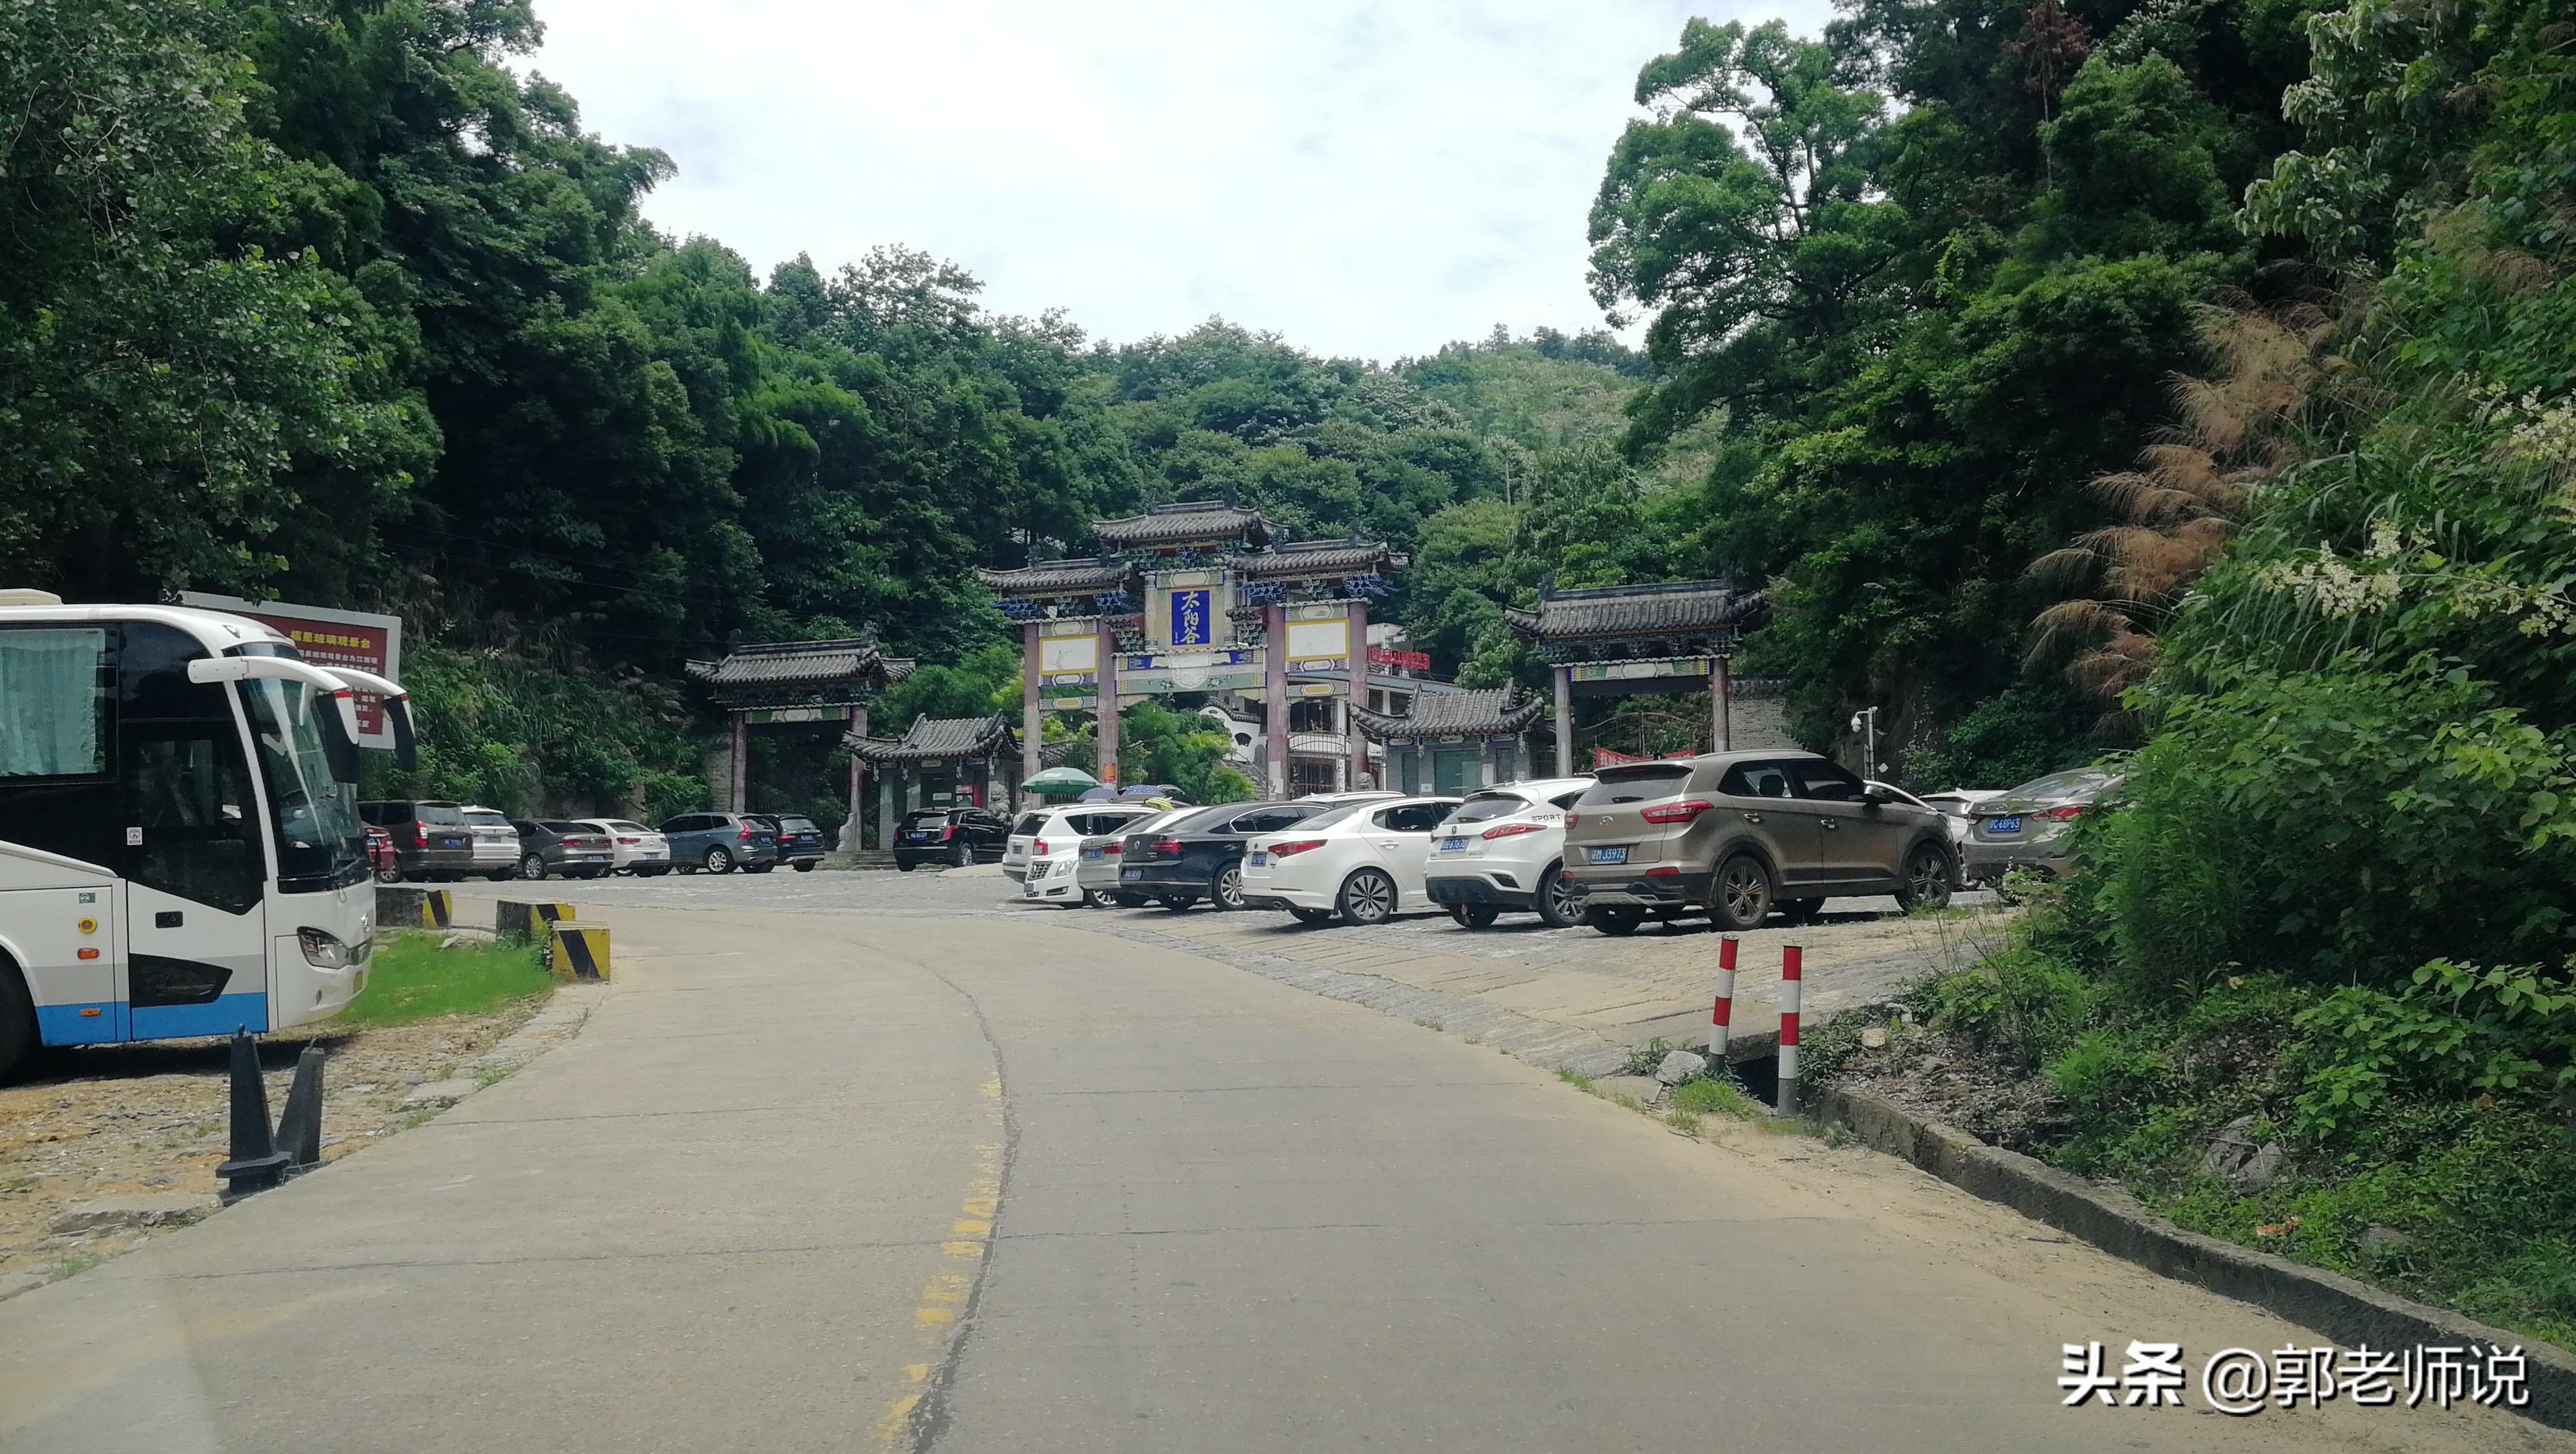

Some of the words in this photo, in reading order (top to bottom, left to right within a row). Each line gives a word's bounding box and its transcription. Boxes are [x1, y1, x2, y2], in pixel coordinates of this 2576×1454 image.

[1180, 590, 1200, 645] 太阳谷
[1531, 814, 1561, 822] SPORT
